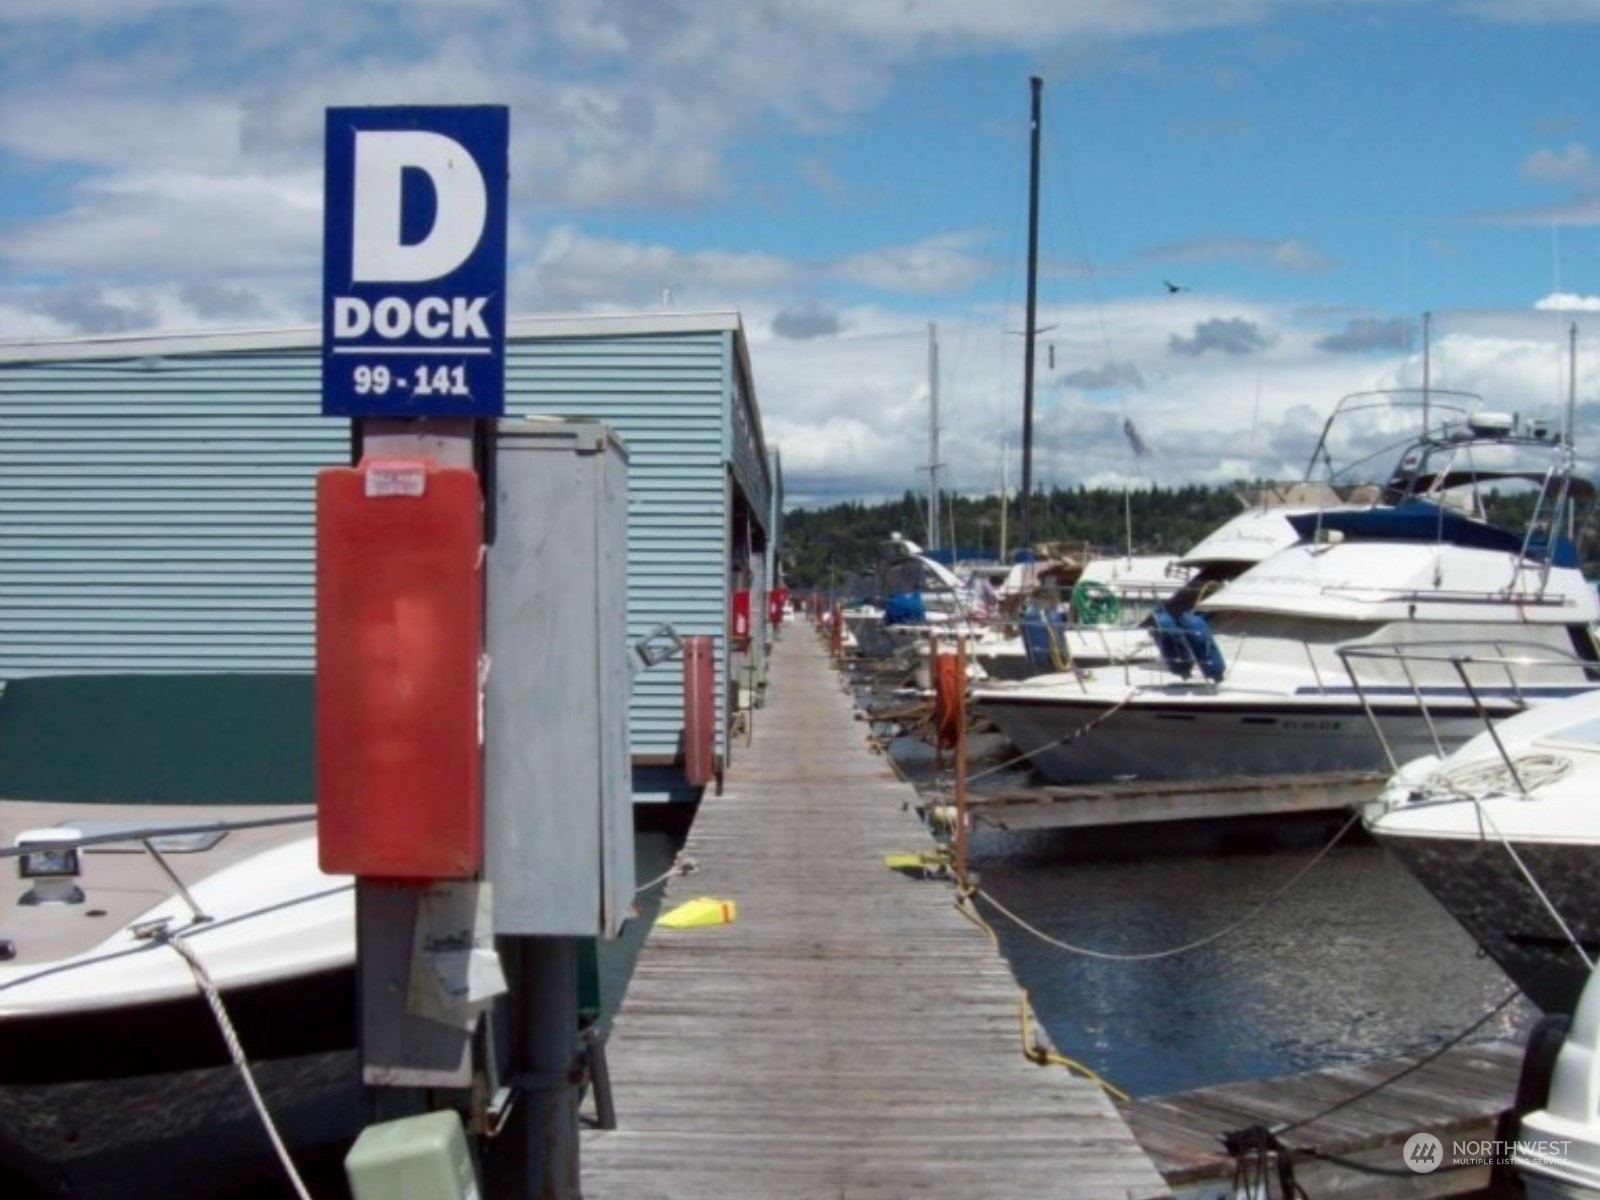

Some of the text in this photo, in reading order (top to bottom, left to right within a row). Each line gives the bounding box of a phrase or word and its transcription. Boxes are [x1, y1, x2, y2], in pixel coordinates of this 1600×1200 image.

[353, 131, 487, 282] D
[333, 297, 491, 339] DOCK
[353, 365, 390, 395] 99
[414, 365, 469, 396] 141
